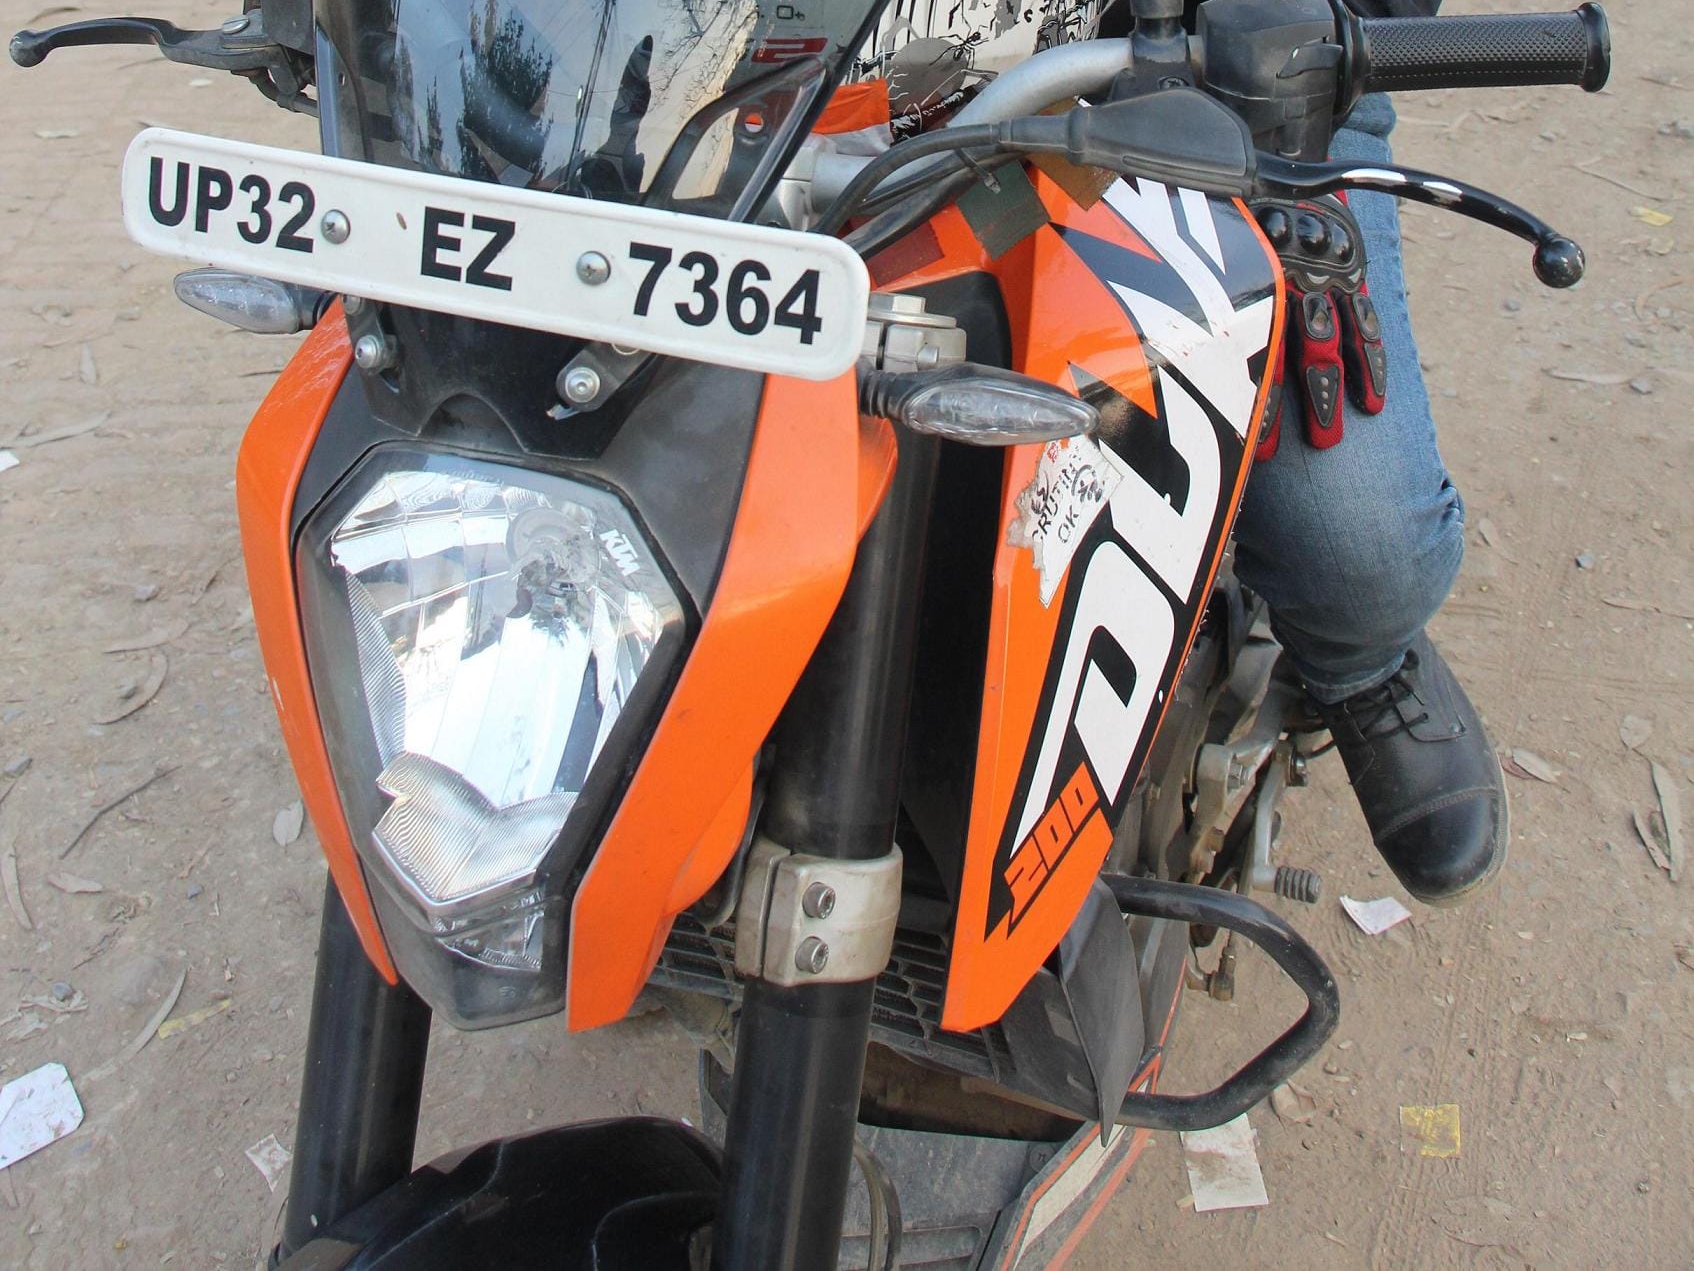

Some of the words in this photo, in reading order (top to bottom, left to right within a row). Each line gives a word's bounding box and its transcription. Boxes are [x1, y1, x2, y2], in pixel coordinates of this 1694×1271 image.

[147, 157, 316, 254] UP32
[420, 205, 517, 291] EZ
[628, 242, 823, 345] 7364
[599, 529, 641, 577] KTM
[1058, 504, 1080, 544] OK
[1003, 761, 1099, 924] 200
